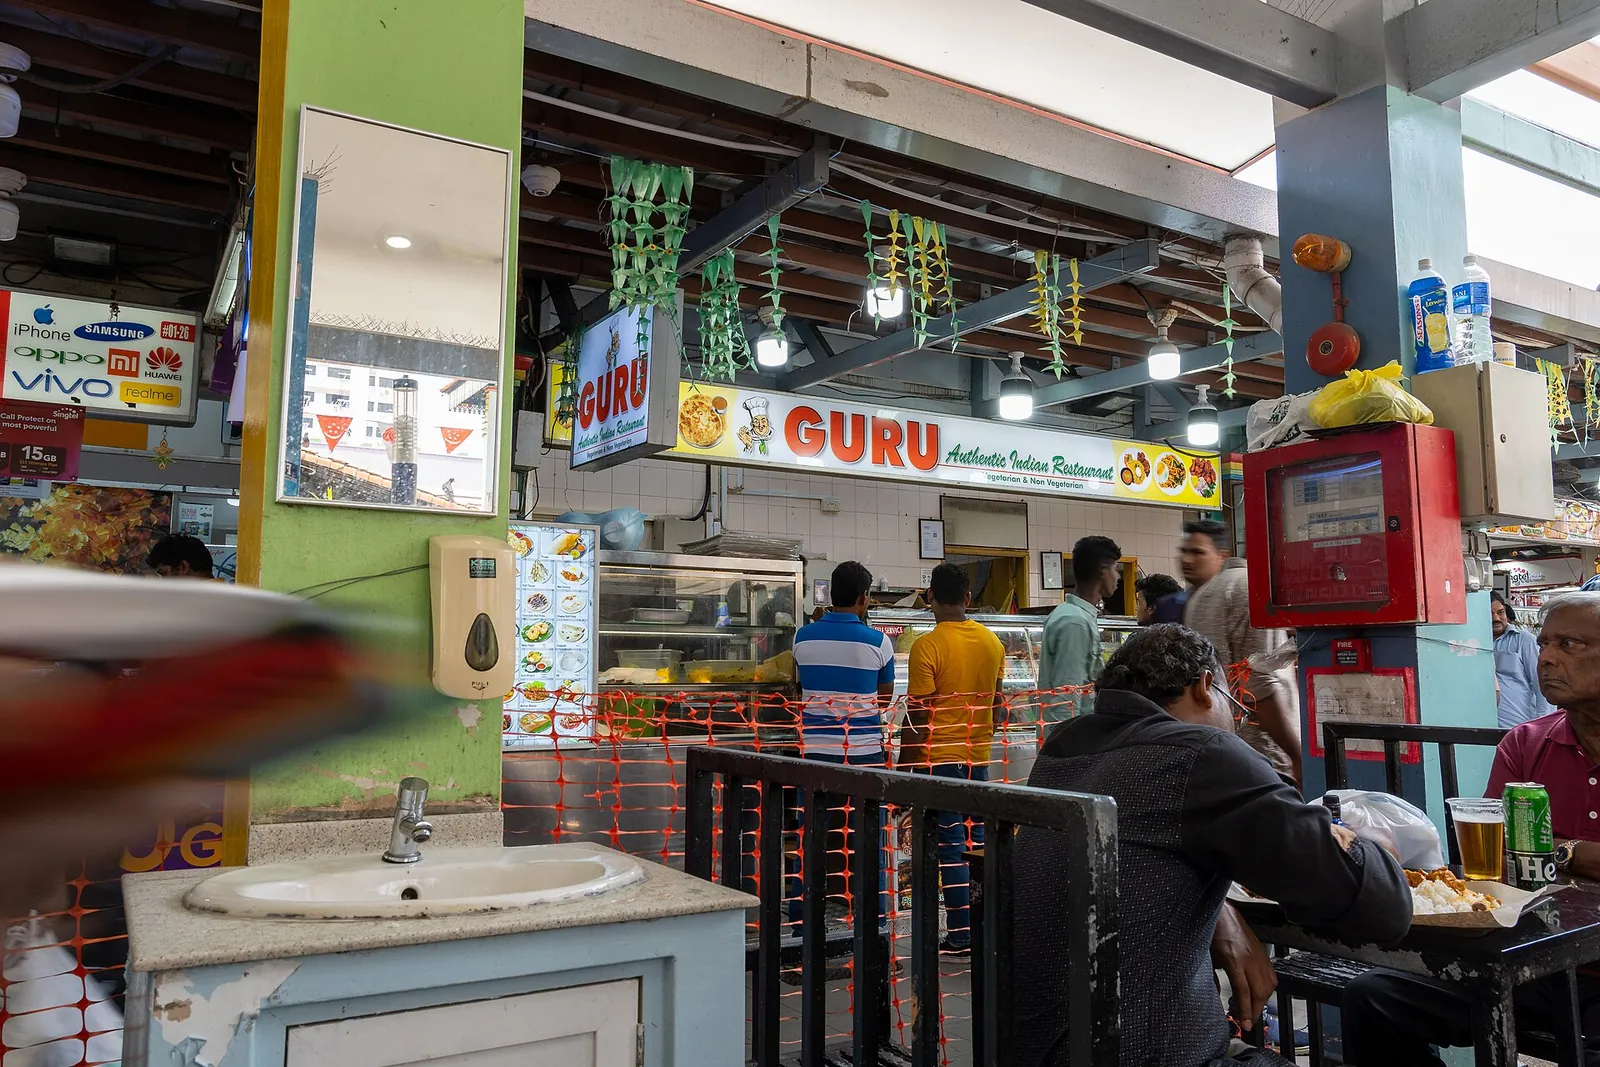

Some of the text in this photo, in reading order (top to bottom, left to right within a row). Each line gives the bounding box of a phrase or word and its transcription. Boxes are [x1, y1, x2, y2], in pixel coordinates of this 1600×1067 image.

[14, 323, 71, 342] iPhone
[84, 324, 145, 340] SAMSUNG
[161, 324, 190, 340] #01-26
[144, 371, 182, 381] HUAWEI
[125, 387, 174, 402] realme
[579, 352, 648, 431] GURU
[0, 412, 16, 420] Call
[17, 414, 44, 423] Protect
[53, 410, 79, 420] Singtel
[2, 421, 57, 432] most powerful
[615, 414, 646, 437] Restaurant
[783, 405, 939, 471] GURU
[945, 443, 1115, 481] Authentic Indian Restaurant
[984, 472, 1084, 490] egetarian & Non Vegetarian
[1518, 857, 1558, 882] He
